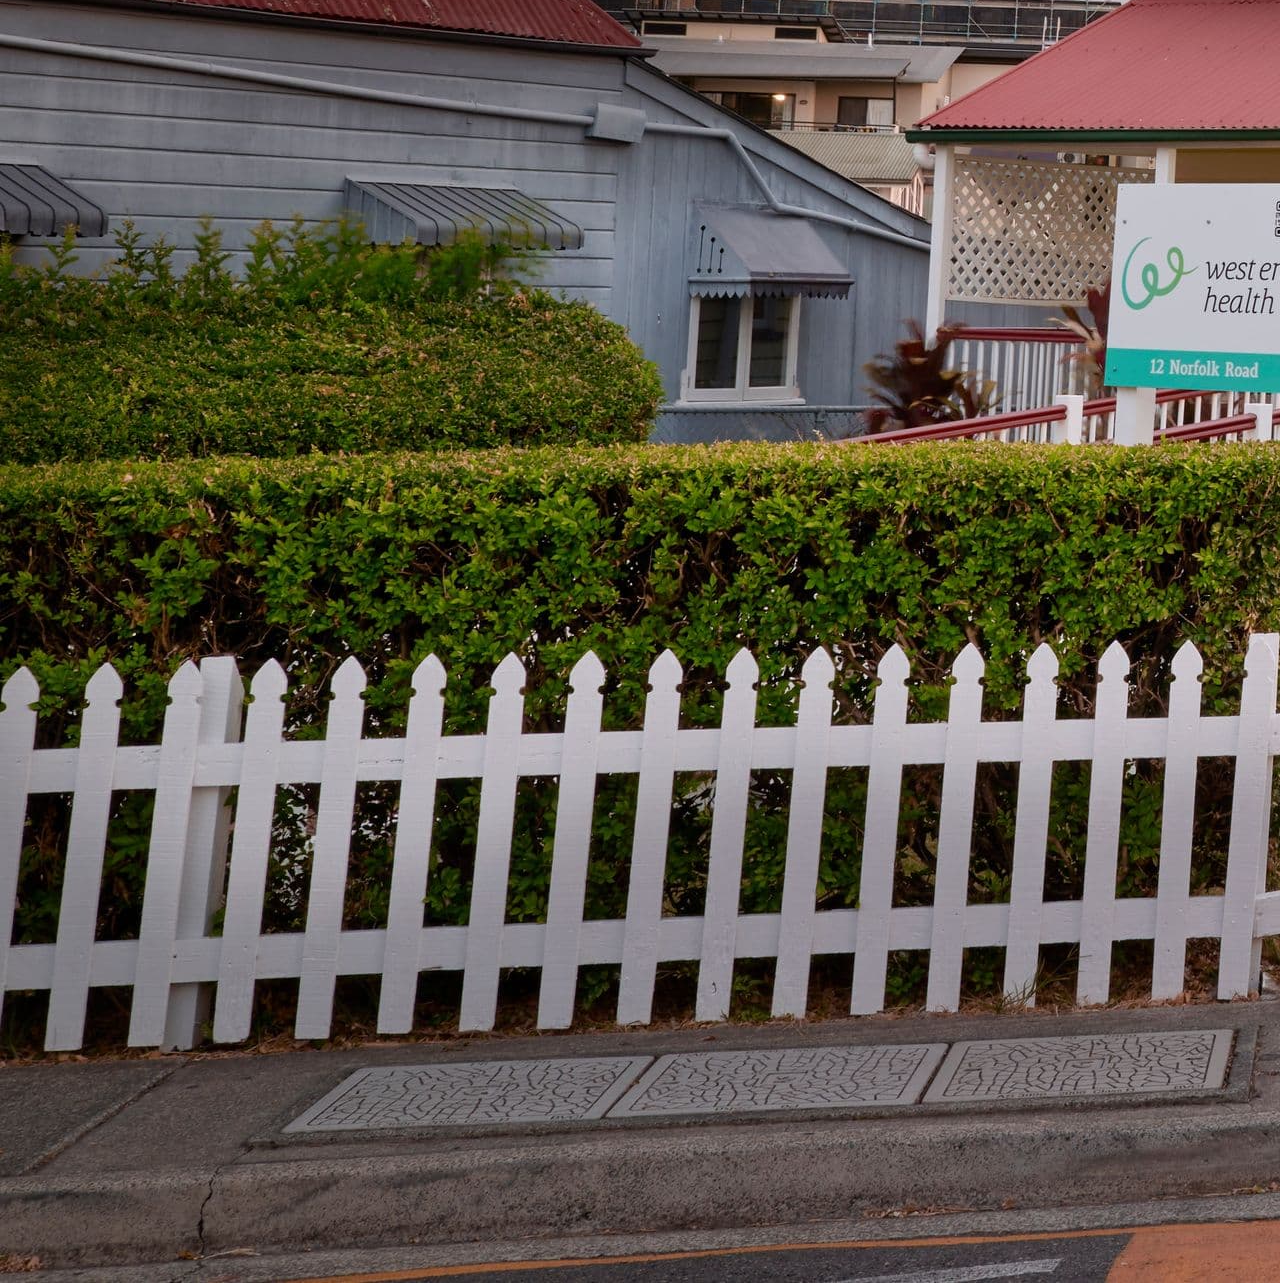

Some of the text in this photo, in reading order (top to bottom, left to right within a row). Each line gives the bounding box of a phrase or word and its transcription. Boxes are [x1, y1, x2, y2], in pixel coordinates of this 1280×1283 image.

[1204, 259, 1255, 281] west
[1203, 287, 1275, 314] health
[1150, 358, 1259, 378] 12 Norfolk Road
